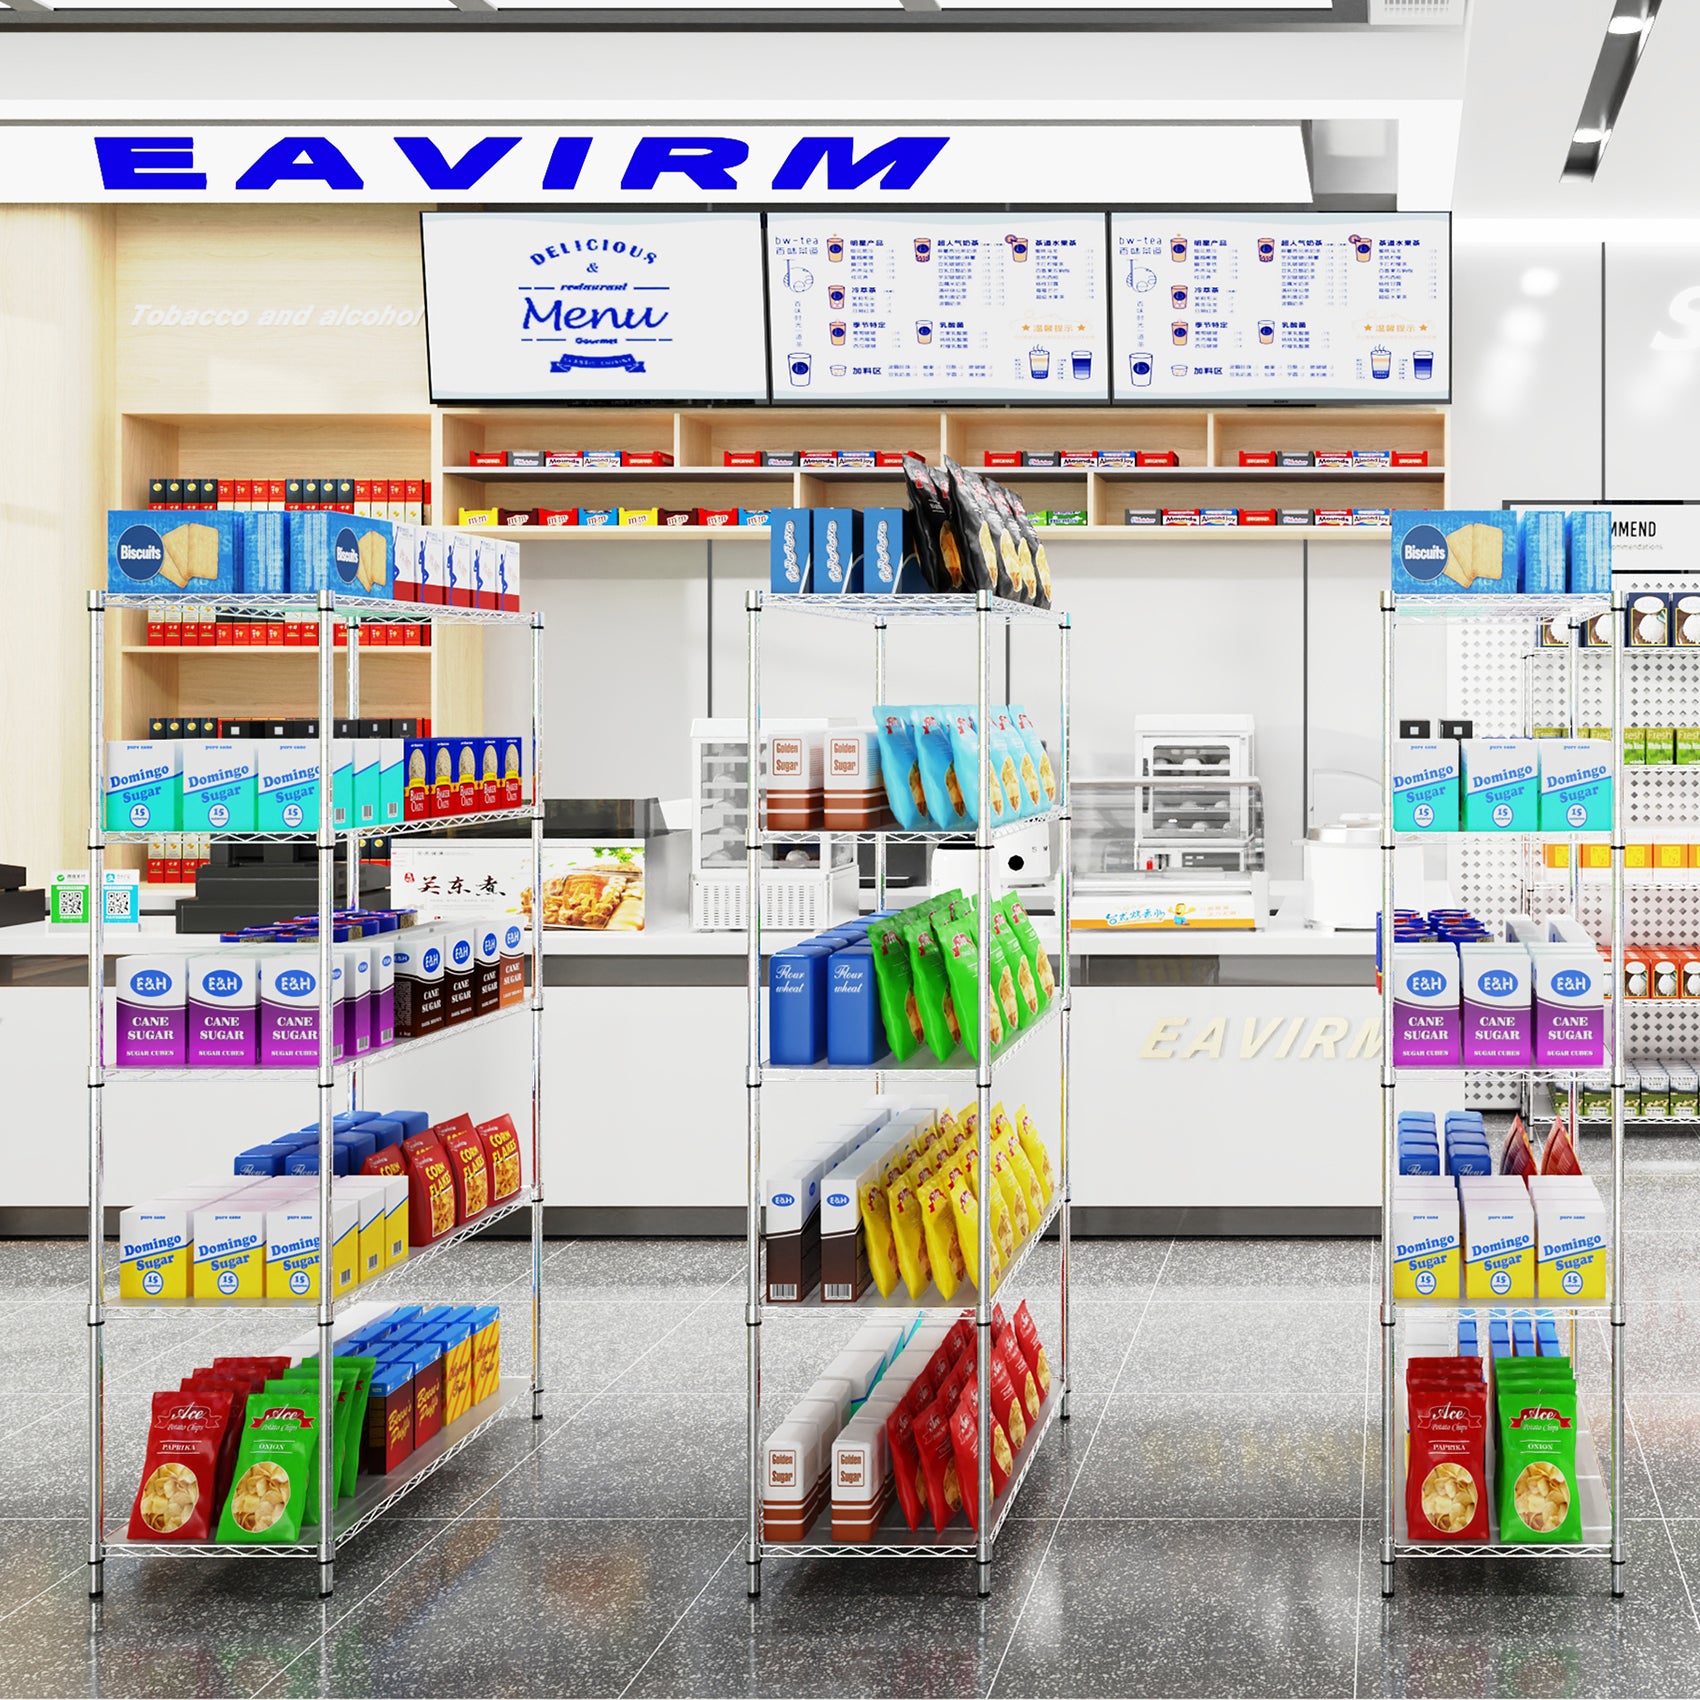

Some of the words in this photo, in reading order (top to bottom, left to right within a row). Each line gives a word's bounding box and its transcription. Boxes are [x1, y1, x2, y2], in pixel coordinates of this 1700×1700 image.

[94, 136, 950, 190] EAVIRM
[775, 237, 818, 245] bw-tea
[1119, 237, 1162, 245] bw-tea
[530, 239, 657, 265] DELICIOUS
[586, 263, 598, 272] &
[560, 283, 628, 291] restaurant
[131, 304, 249, 326] Tobacco
[258, 304, 315, 326] and
[318, 304, 425, 326] alcohol
[523, 297, 668, 331] Menu
[1611, 521, 1656, 537] MMEND
[121, 545, 161, 560] Biscuits
[336, 547, 359, 564] Biscuits
[1404, 545, 1446, 561] Biscuits
[776, 743, 798, 753] Golden
[834, 743, 856, 753] Golden
[776, 760, 798, 772] Sugar
[834, 760, 856, 772] Sugar
[110, 765, 169, 788] Domingo
[188, 765, 249, 788] Domingo
[1394, 765, 1454, 788] Domingo
[1473, 765, 1532, 788] Domingo
[1547, 765, 1606, 788] Domingo
[122, 786, 162, 803] Sugar
[201, 786, 241, 803] Sugar
[276, 786, 315, 803] Sugar
[1406, 784, 1446, 803] Sugar
[1485, 784, 1525, 803] Sugar
[1559, 784, 1599, 803] Sugar
[1419, 808, 1429, 816] 15
[1498, 808, 1508, 816] 15
[418, 876, 506, 896] 关东煮
[507, 930, 520, 944] E&H
[455, 945, 469, 960] E&H
[425, 953, 439, 968] E&H
[505, 962, 520, 973] CANE
[503, 973, 522, 985] SUGAR
[776, 965, 804, 980] Flour
[834, 965, 864, 980] Flour
[136, 977, 167, 990] E&H
[208, 977, 238, 990] E&H
[281, 977, 311, 990] E&H
[453, 979, 470, 991] CANE
[776, 983, 804, 993] wheat
[834, 983, 862, 993] wheat
[1413, 977, 1442, 990] E&H
[1484, 977, 1513, 990] E&H
[1557, 977, 1586, 990] E&H
[423, 988, 439, 1000] CANE
[451, 990, 472, 1004] SUGAR
[421, 1000, 442, 1013] SUGAR
[132, 1017, 169, 1027] CANE
[204, 1017, 240, 1027] CANE
[277, 1017, 313, 1027] CANE
[1408, 1017, 1444, 1027] CANE
[1480, 1017, 1515, 1027] CANE
[1553, 1017, 1588, 1027] CANE
[128, 1031, 174, 1040] SUGAR
[200, 1031, 244, 1040] SUGAR
[273, 1031, 318, 1040] SUGAR
[1139, 1017, 1383, 1058] EAVIRM
[1404, 1030, 1448, 1040] SUGAR
[1475, 1030, 1520, 1040] SUGAR
[1548, 1030, 1593, 1040] SUGAR
[489, 1130, 511, 1148] CORN
[492, 1139, 517, 1164] FLAKES
[425, 1162, 445, 1180] CORN
[430, 1174, 451, 1197] FLAKES
[124, 1234, 181, 1257] Domingo
[198, 1234, 257, 1257] Domingo
[271, 1236, 319, 1256] Doming
[1397, 1234, 1455, 1256] Domingo
[1471, 1234, 1529, 1256] Domingo
[1543, 1234, 1601, 1256] Domingo
[136, 1253, 174, 1271] Sugar
[211, 1253, 249, 1271] Sugar
[1409, 1253, 1447, 1271] Sugar
[1484, 1253, 1522, 1271] Sugar
[1555, 1253, 1594, 1271] Sugar
[172, 1402, 206, 1420] Ace
[266, 1404, 300, 1420] Ace
[1432, 1402, 1466, 1419] Ace
[1523, 1404, 1556, 1420] Ace
[772, 1454, 793, 1465] Golden
[840, 1454, 861, 1465] Golden
[772, 1471, 793, 1483] Sugar
[840, 1471, 861, 1483] Sugar
